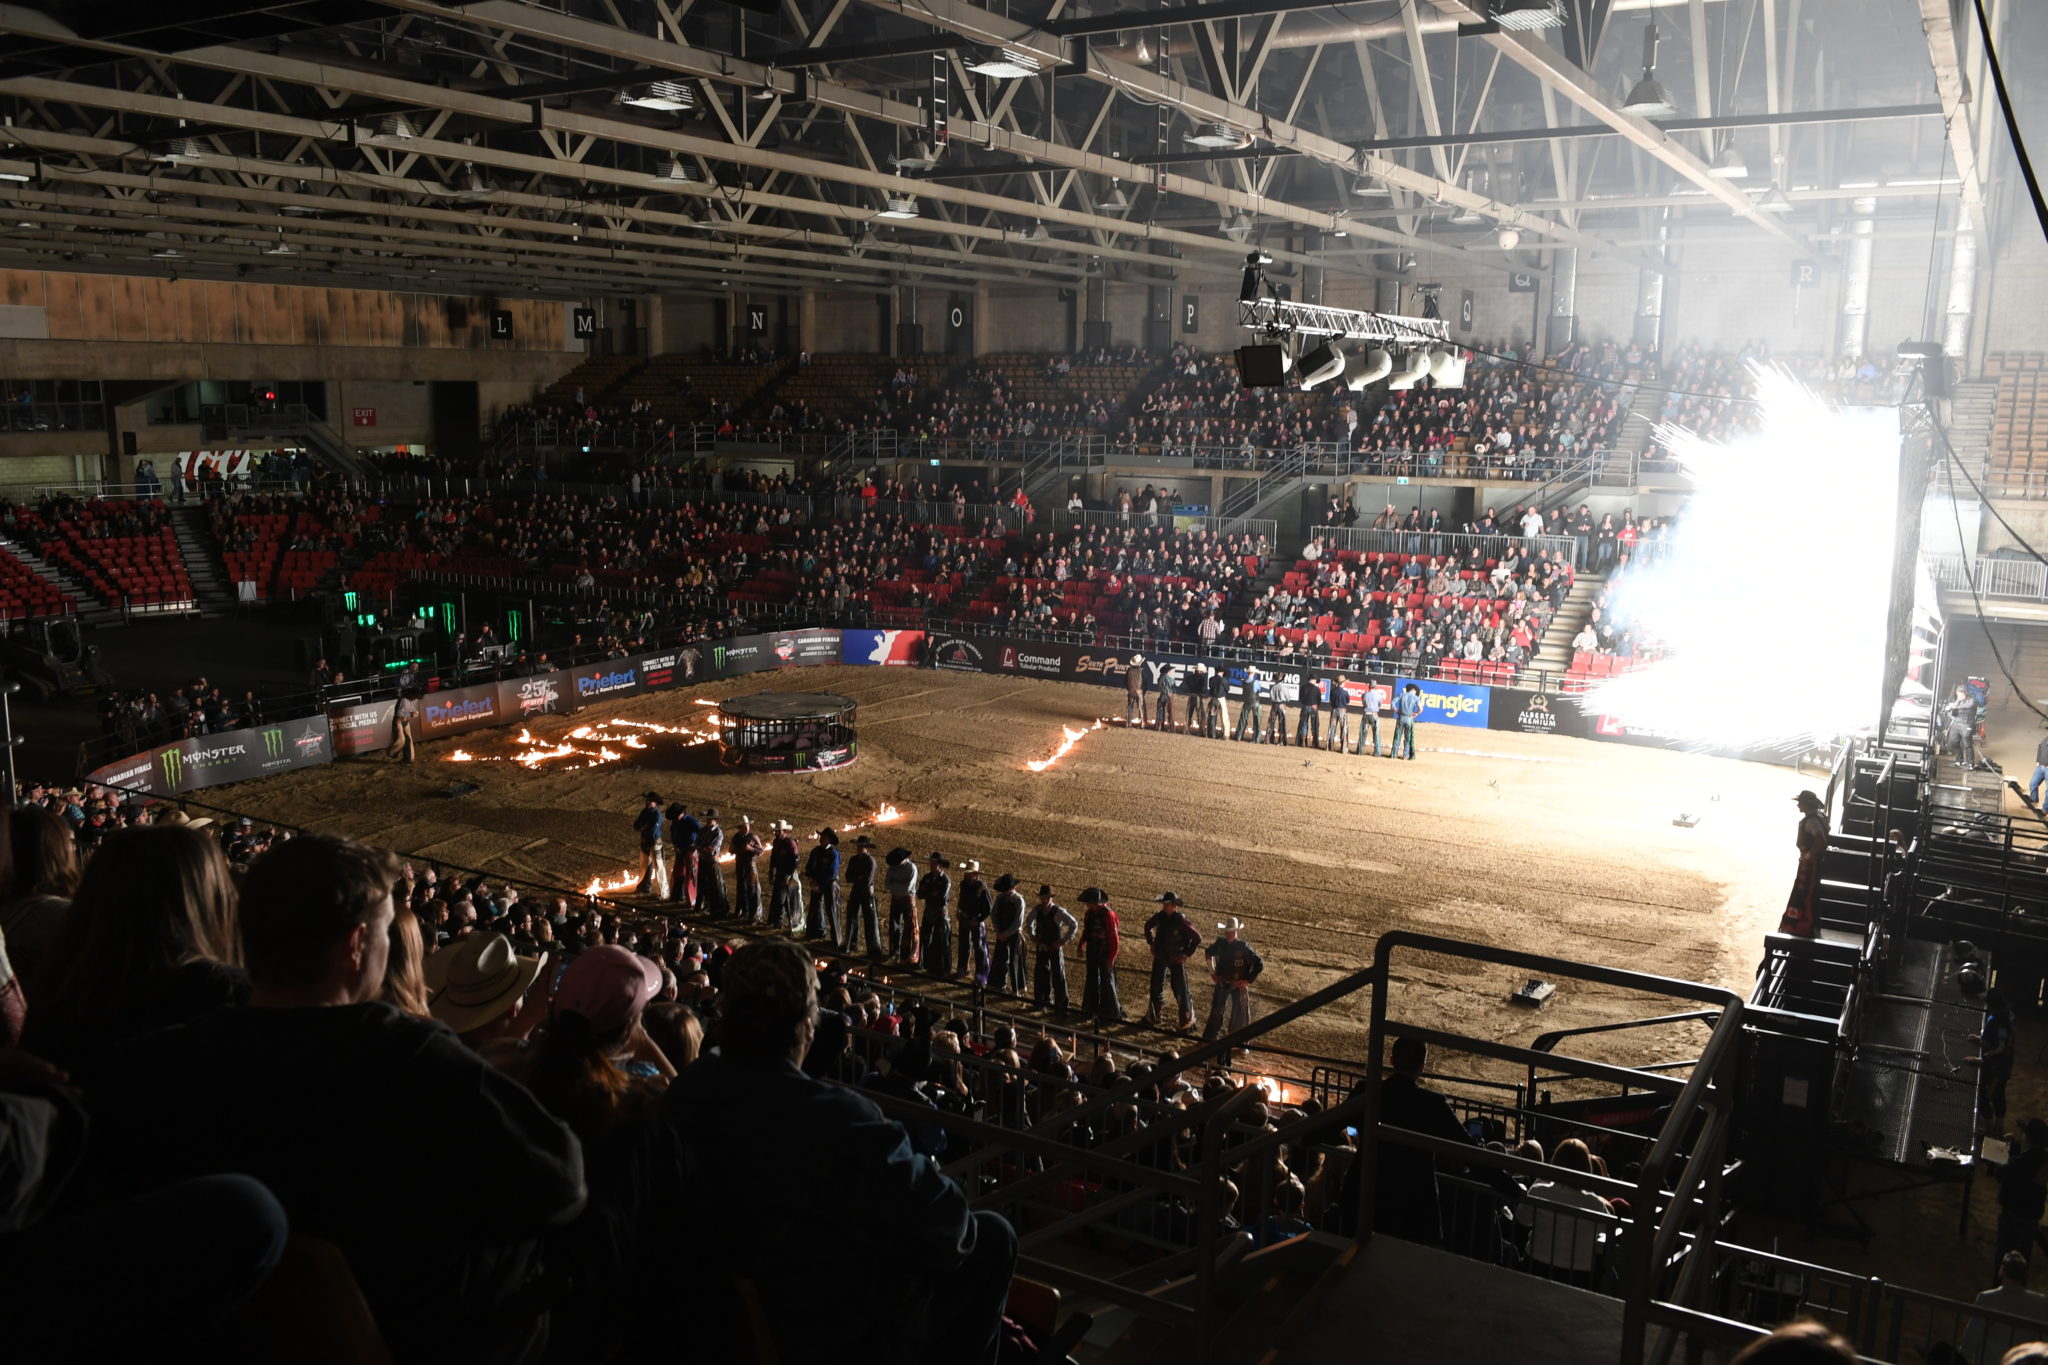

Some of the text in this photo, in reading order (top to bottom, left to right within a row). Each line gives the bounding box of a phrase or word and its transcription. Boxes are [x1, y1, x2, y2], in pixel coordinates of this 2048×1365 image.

[1797, 264, 1813, 282] R
[951, 307, 963, 328] O
[1186, 304, 1195, 325] P
[1463, 299, 1471, 322] Q
[497, 317, 507, 333] L
[577, 315, 593, 332] M
[751, 312, 764, 330] N
[355, 409, 373, 417] EXIT
[798, 637, 822, 645] CANADIAN
[726, 647, 758, 657] MONSTER
[941, 639, 955, 648] BLACK
[966, 641, 983, 660] COMPANY
[642, 658, 659, 667] CONNECT
[649, 663, 662, 671] SOCIAL
[1018, 653, 1061, 667] Command
[1020, 662, 1060, 673] Tubular Products
[578, 669, 635, 693] Priefert
[1147, 661, 1216, 690] YEI
[600, 685, 614, 693] Ranch
[614, 681, 636, 691] Equipment
[1403, 687, 1483, 718] rangler
[353, 712, 369, 721] WITH
[426, 697, 493, 724] Priefert
[452, 715, 468, 724] Ranch
[468, 710, 494, 720] Equipment
[1519, 710, 1556, 721] ALBERTA
[1518, 716, 1556, 727] PREMIUM
[182, 743, 247, 765] MONSTER
[192, 756, 238, 770] ENERGY
[261, 757, 292, 769] MONSTER
[106, 762, 152, 786] CANADIAN FINALS
